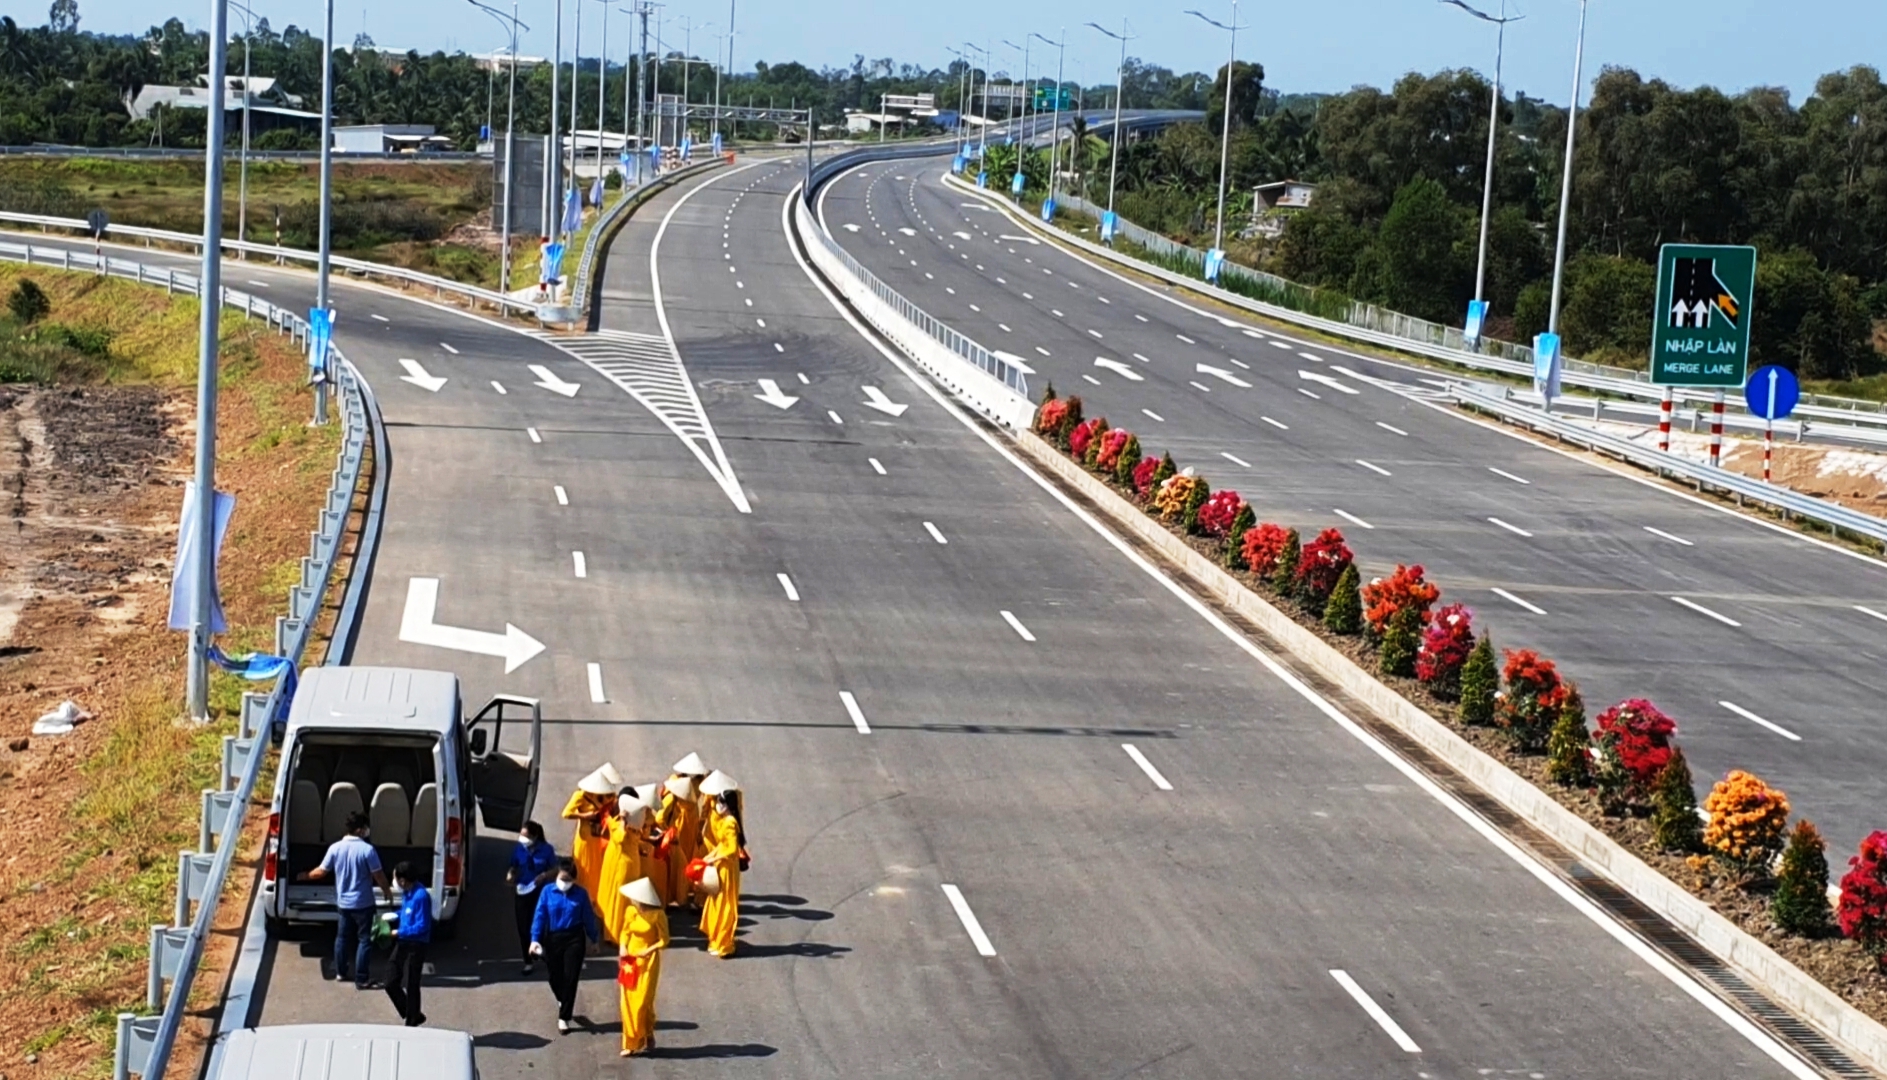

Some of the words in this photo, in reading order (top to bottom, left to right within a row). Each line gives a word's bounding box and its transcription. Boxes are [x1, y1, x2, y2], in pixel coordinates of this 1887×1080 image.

[1707, 337, 1736, 354] LÀN
[1664, 362, 1700, 374] MERGE
[1704, 364, 1734, 375] LANE
